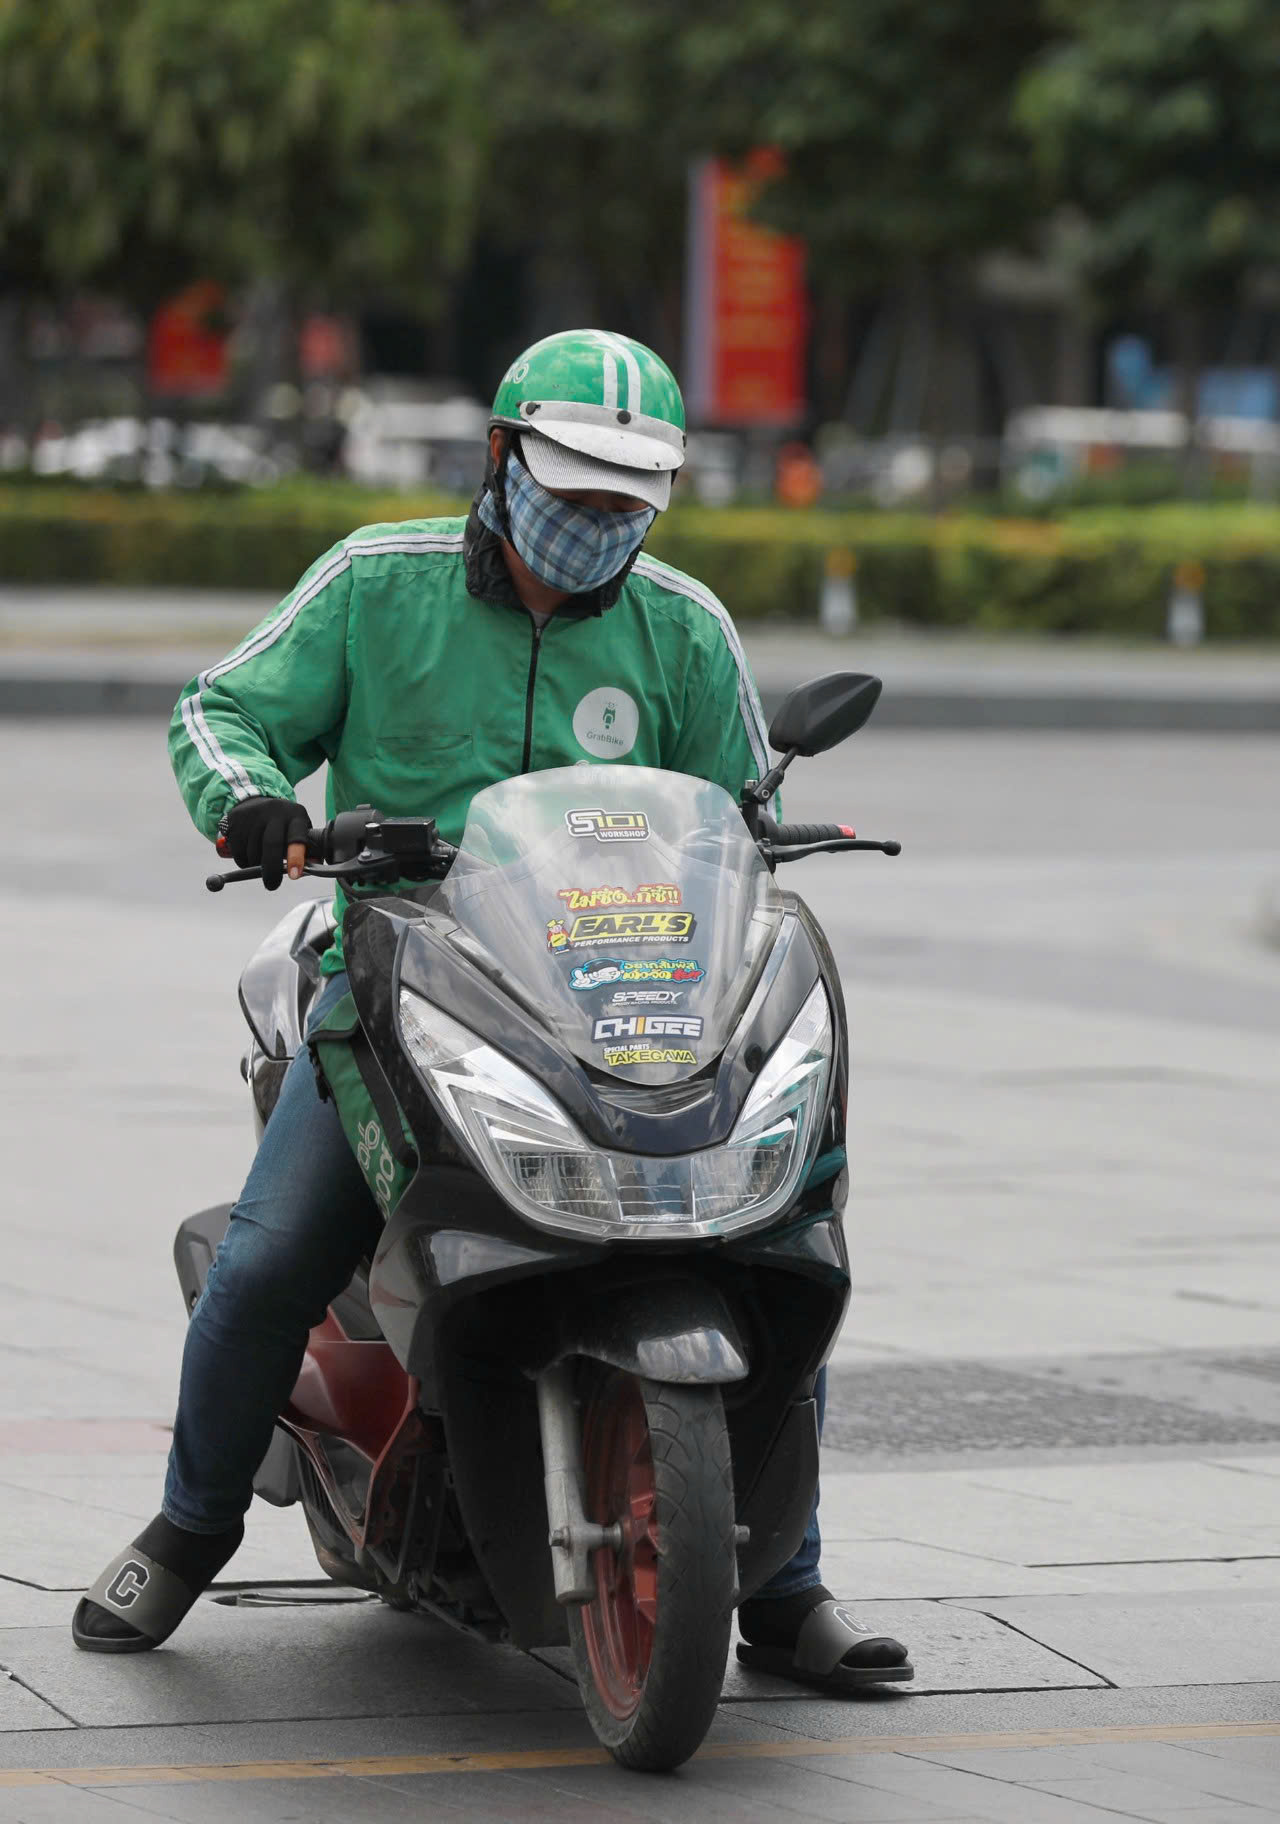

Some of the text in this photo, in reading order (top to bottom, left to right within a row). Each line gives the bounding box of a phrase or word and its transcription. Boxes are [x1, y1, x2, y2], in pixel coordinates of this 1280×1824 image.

[587, 731, 624, 745] GrabBike
[574, 916, 688, 937] EARL'S
[574, 936, 641, 948] PERFORMANCE
[612, 991, 683, 1002] SPEEDY
[595, 1016, 701, 1039] CHIGEE
[606, 1050, 695, 1064] TAKEGAWA
[105, 1560, 149, 1608] C
